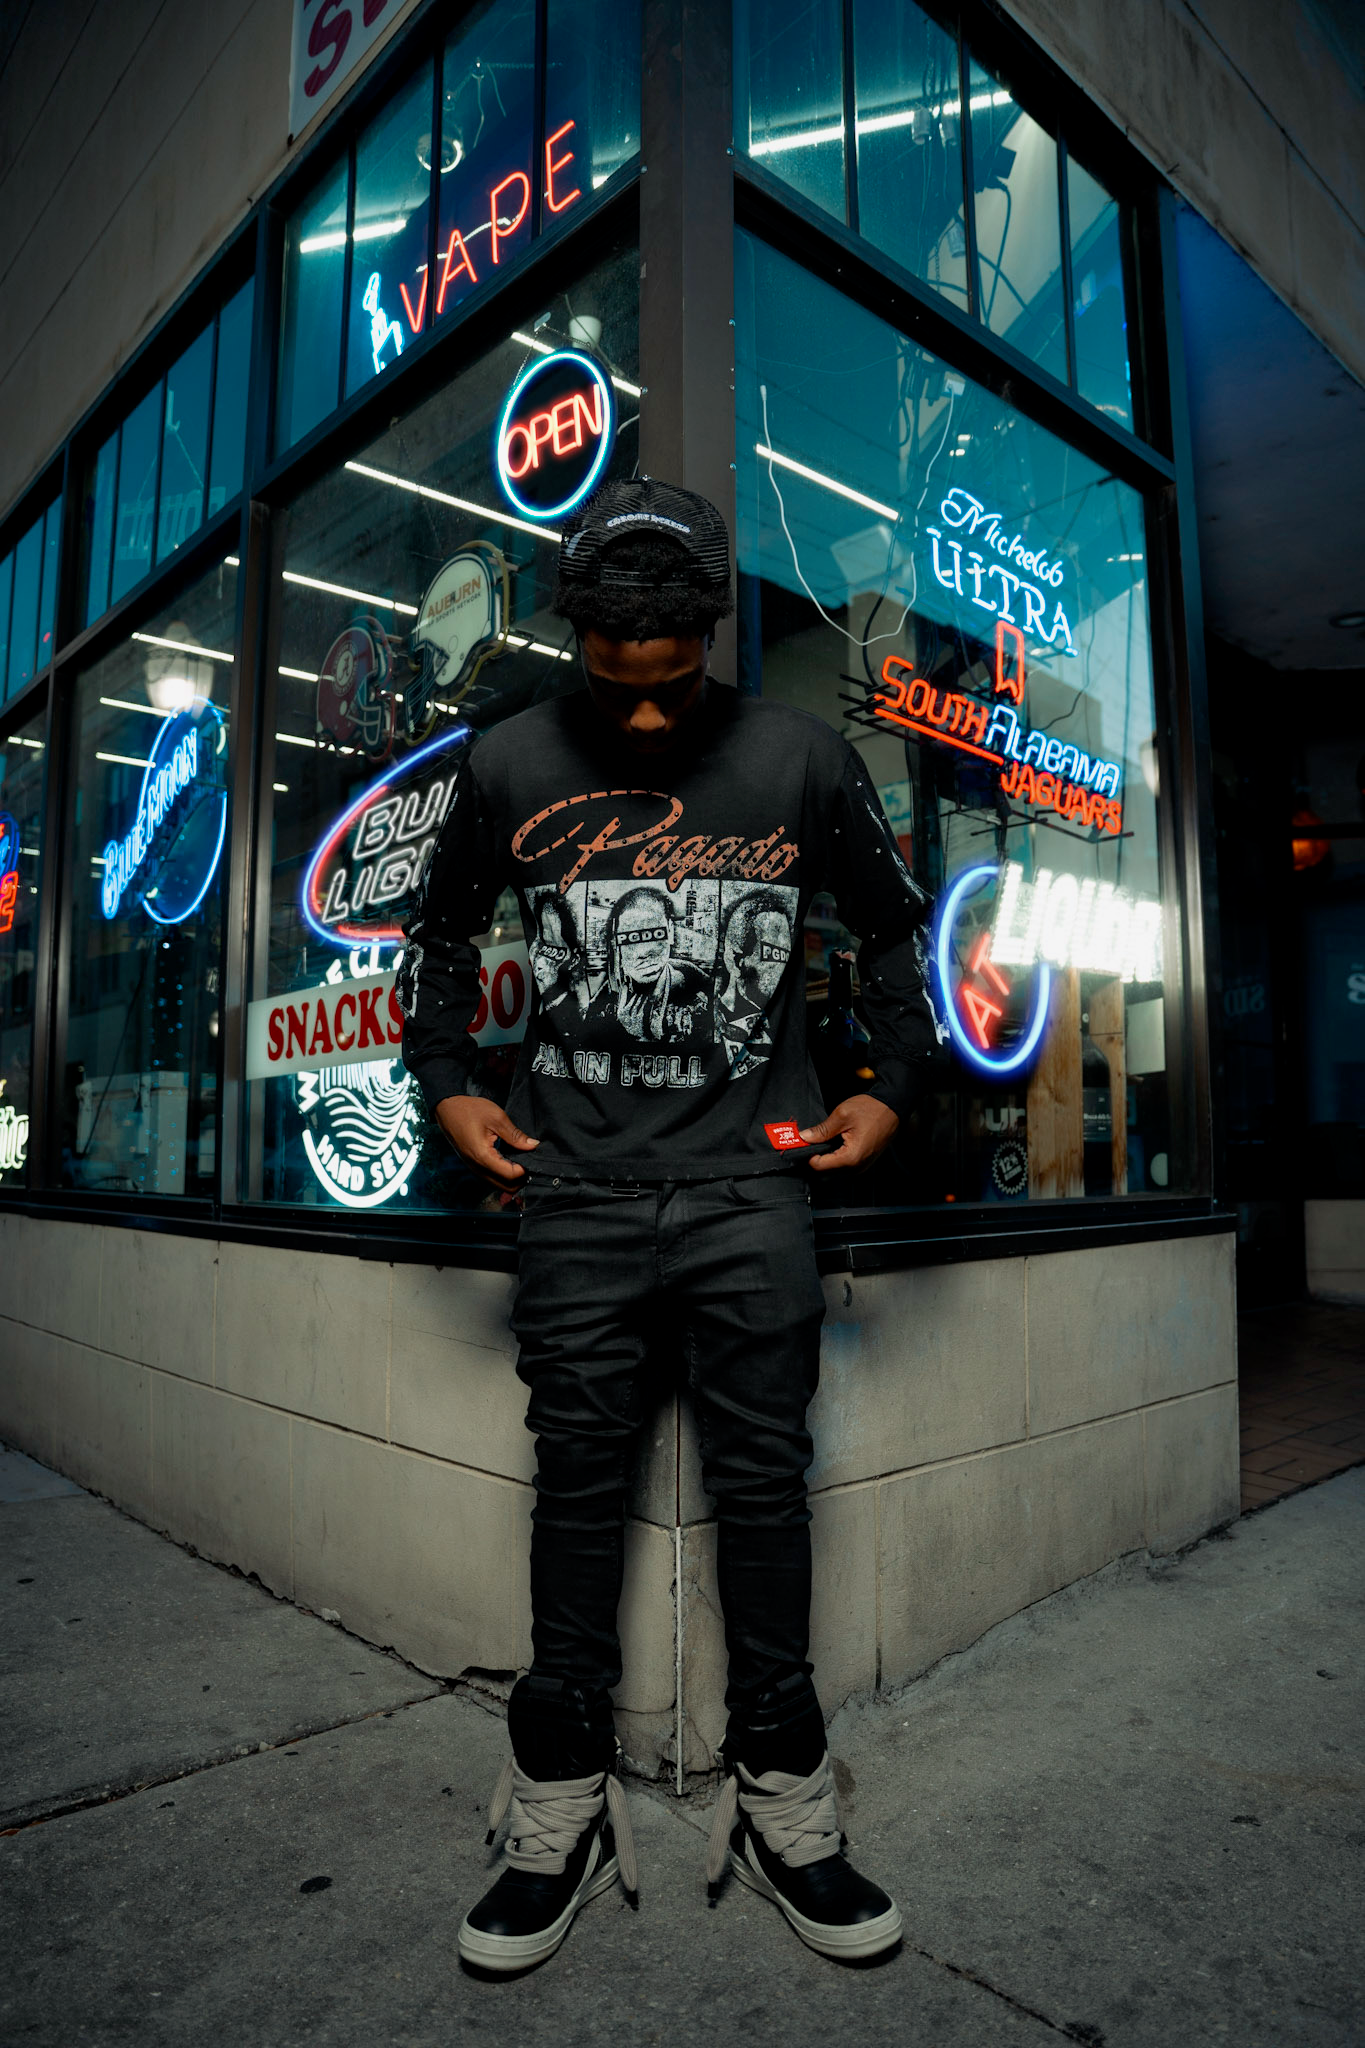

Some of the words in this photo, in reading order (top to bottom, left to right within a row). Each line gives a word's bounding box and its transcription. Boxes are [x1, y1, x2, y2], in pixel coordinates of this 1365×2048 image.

[400, 119, 581, 333] VAPE
[503, 383, 603, 479] OPEN
[940, 487, 1064, 587] Michelob
[427, 575, 481, 619] AUBURN
[925, 527, 1078, 658] ULTRA
[873, 655, 989, 743] SOUTH
[986, 703, 1122, 799] ALABAMA
[511, 788, 800, 895] Pagado
[1000, 760, 1122, 835] JAGUARS
[322, 838, 436, 924] LIG
[538, 945, 566, 960] PGDO
[616, 928, 667, 945] PGDO
[962, 931, 1010, 1050] AT
[620, 1053, 709, 1089] FULL
[315, 1134, 365, 1192] HARD
